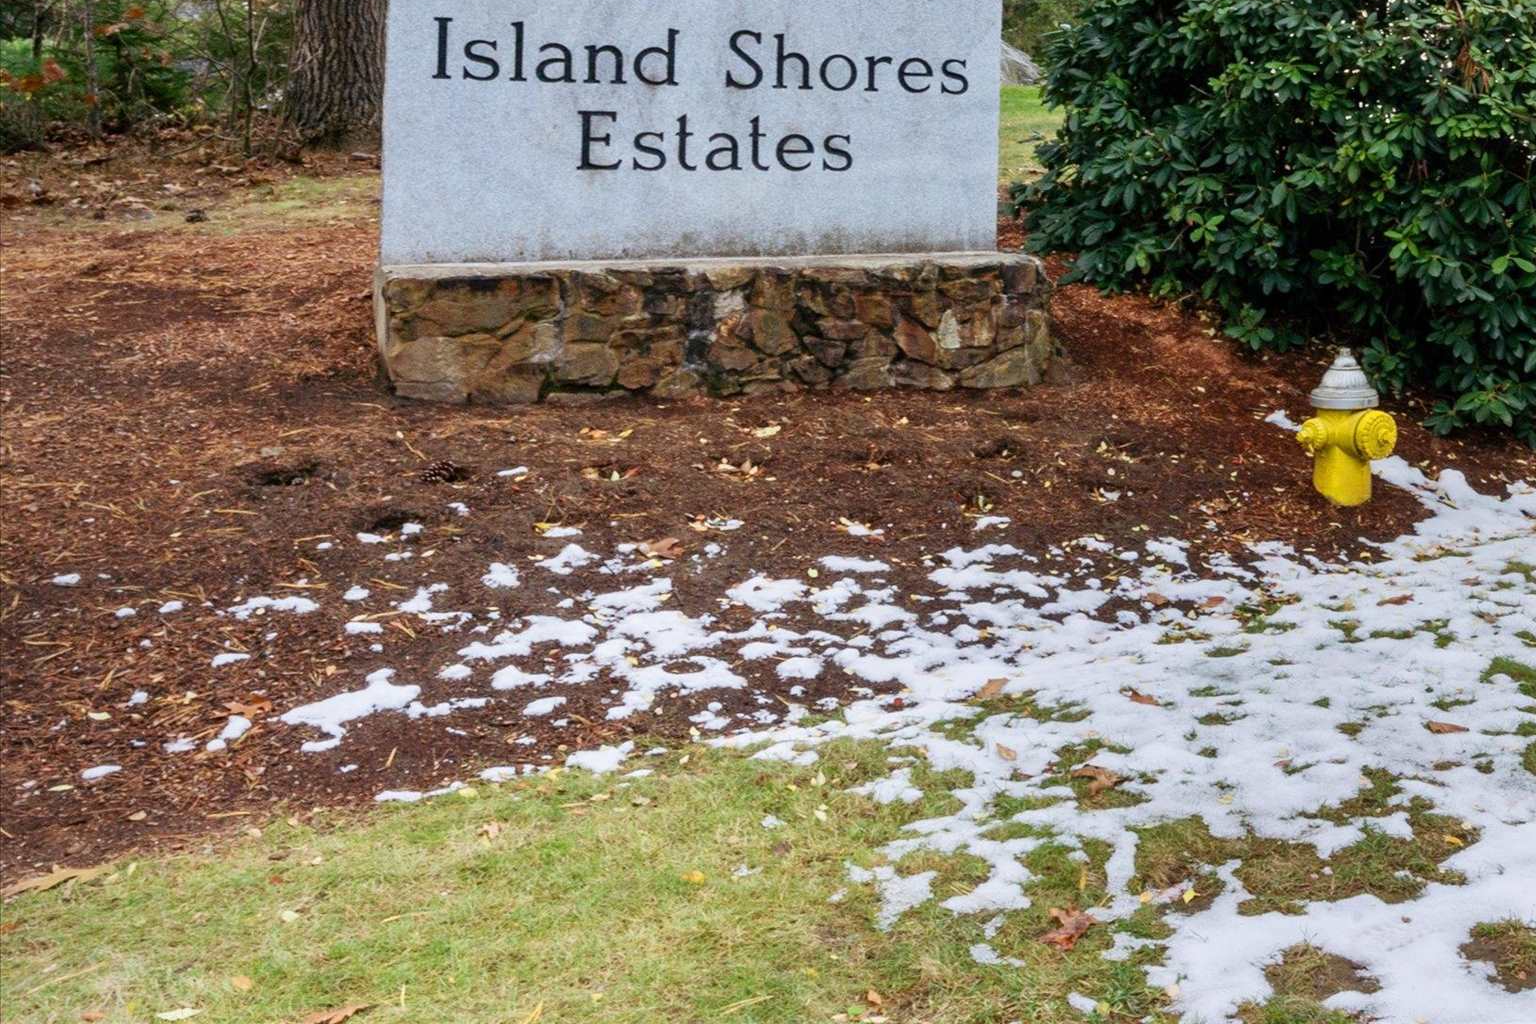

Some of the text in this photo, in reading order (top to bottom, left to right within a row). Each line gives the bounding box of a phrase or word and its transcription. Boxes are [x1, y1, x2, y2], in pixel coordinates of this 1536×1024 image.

[433, 17, 969, 94] Island Shores
[577, 111, 853, 171] Estates
